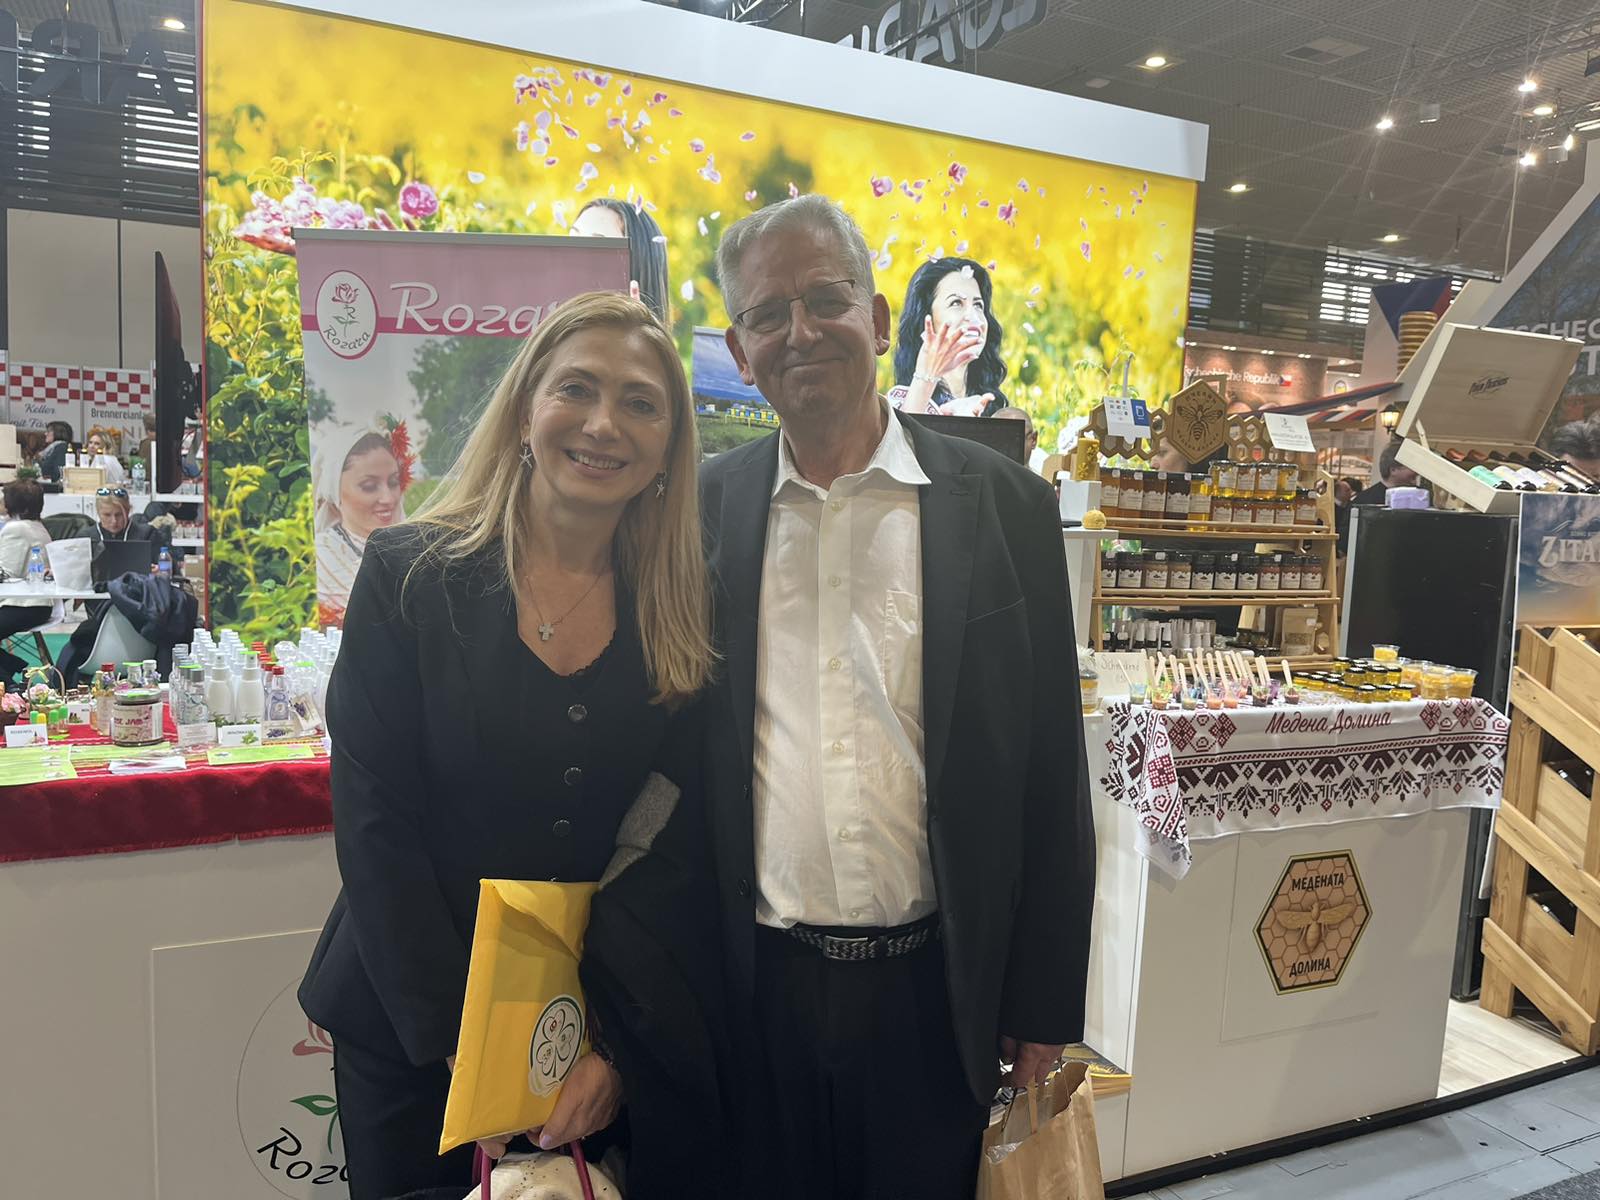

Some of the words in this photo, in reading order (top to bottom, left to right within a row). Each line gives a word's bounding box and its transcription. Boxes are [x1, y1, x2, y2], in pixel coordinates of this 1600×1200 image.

[390, 281, 559, 335] Roza
[323, 324, 371, 351] Rozara
[1243, 372, 1281, 386] Republik
[1265, 711, 1328, 734] Медена
[1328, 708, 1392, 735] Долина
[1291, 872, 1345, 892] МЕДЕНАТА
[1288, 957, 1331, 978] ДОЛИНА
